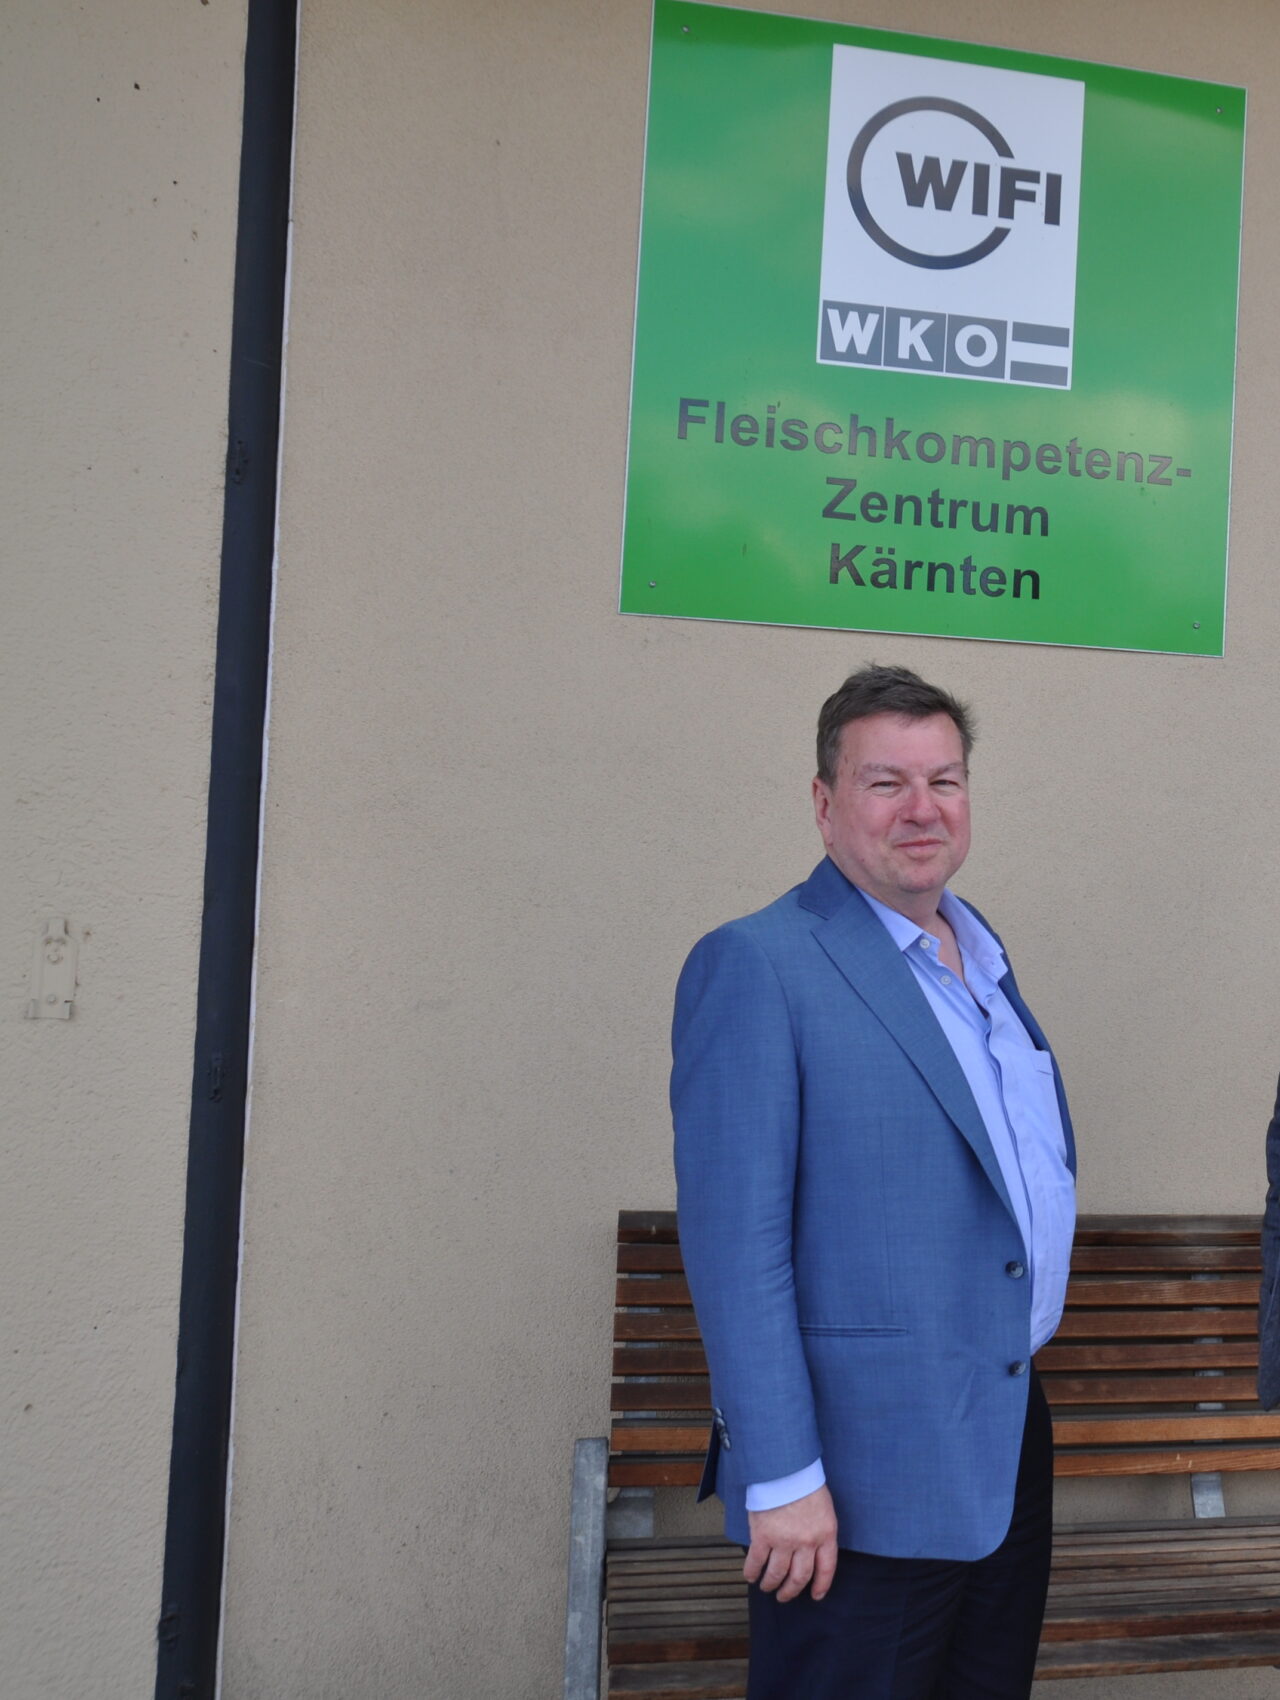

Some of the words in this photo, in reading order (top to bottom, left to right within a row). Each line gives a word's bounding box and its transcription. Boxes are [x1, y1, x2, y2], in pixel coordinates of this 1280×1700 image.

[895, 151, 1063, 226] WIFI
[826, 307, 999, 368] WKO
[676, 397, 1193, 486] Fleischkompetenz-
[821, 475, 1050, 537] Zentrum
[827, 542, 1041, 600] Kärnten
